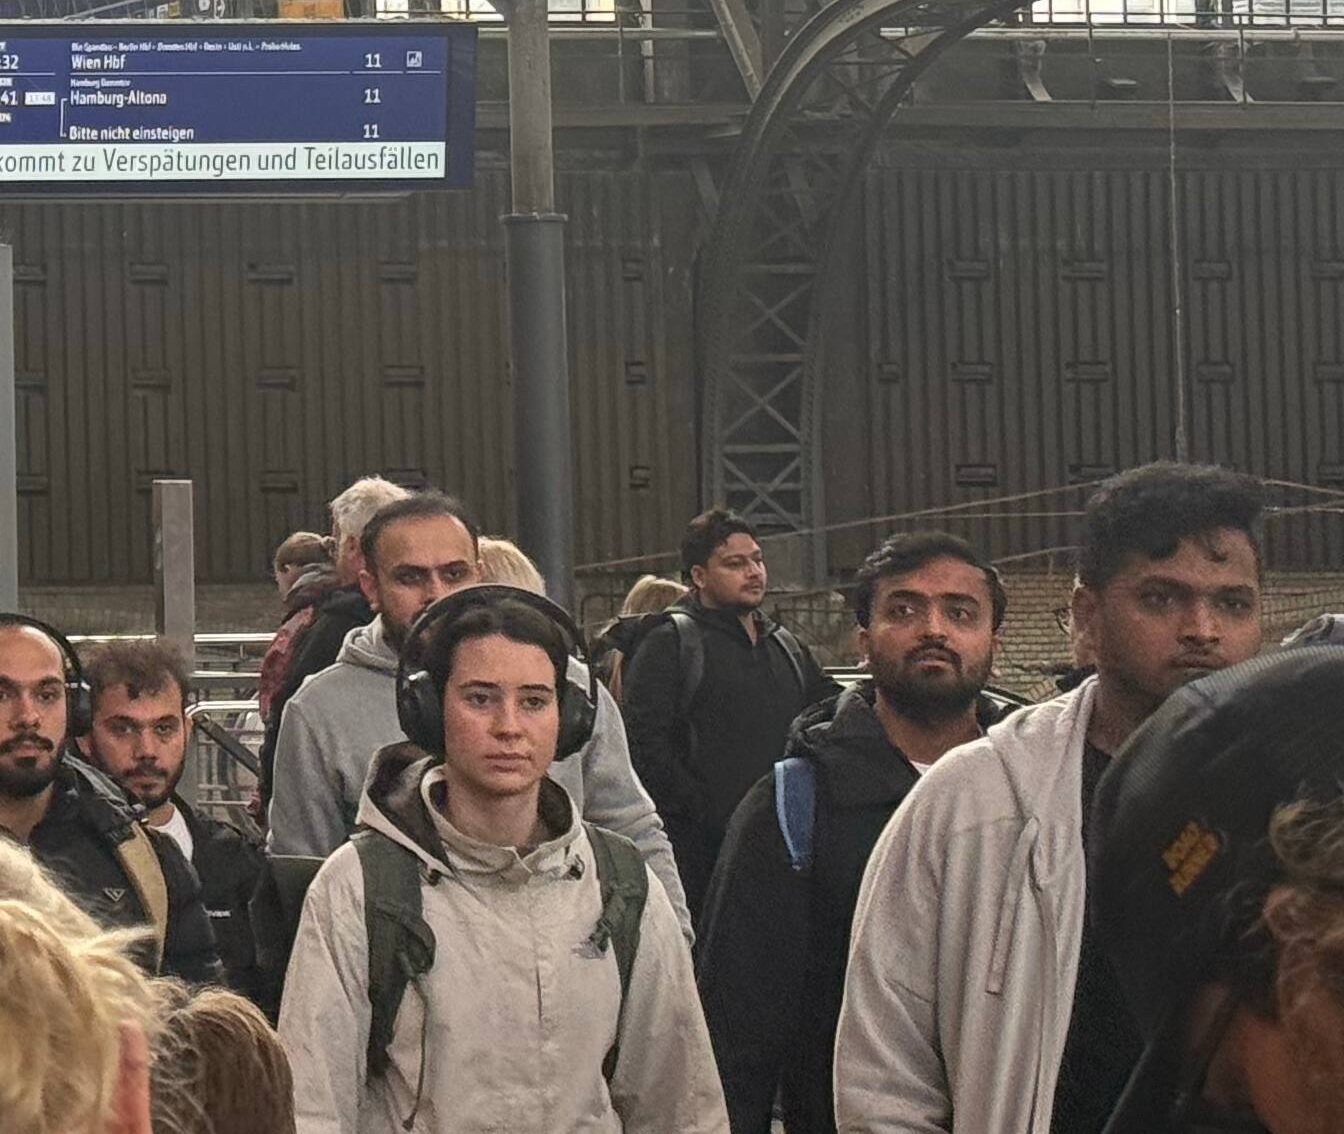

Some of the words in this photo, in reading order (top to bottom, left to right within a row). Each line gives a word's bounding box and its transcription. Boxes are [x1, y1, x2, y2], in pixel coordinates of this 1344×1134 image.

[71, 54, 101, 70] Wien
[103, 54, 127, 70] Hbf
[364, 53, 382, 68] 11
[70, 91, 167, 109] Hamburg-Altona
[364, 88, 381, 103] 11
[69, 125, 99, 141] Bitte
[100, 125, 130, 140] nicht
[132, 125, 194, 143] einsteigen
[363, 123, 380, 139] 11
[72, 152, 96, 172] zu
[103, 147, 251, 178] Verspätungen
[257, 147, 297, 171] und
[303, 145, 440, 171] Teilausfällen
